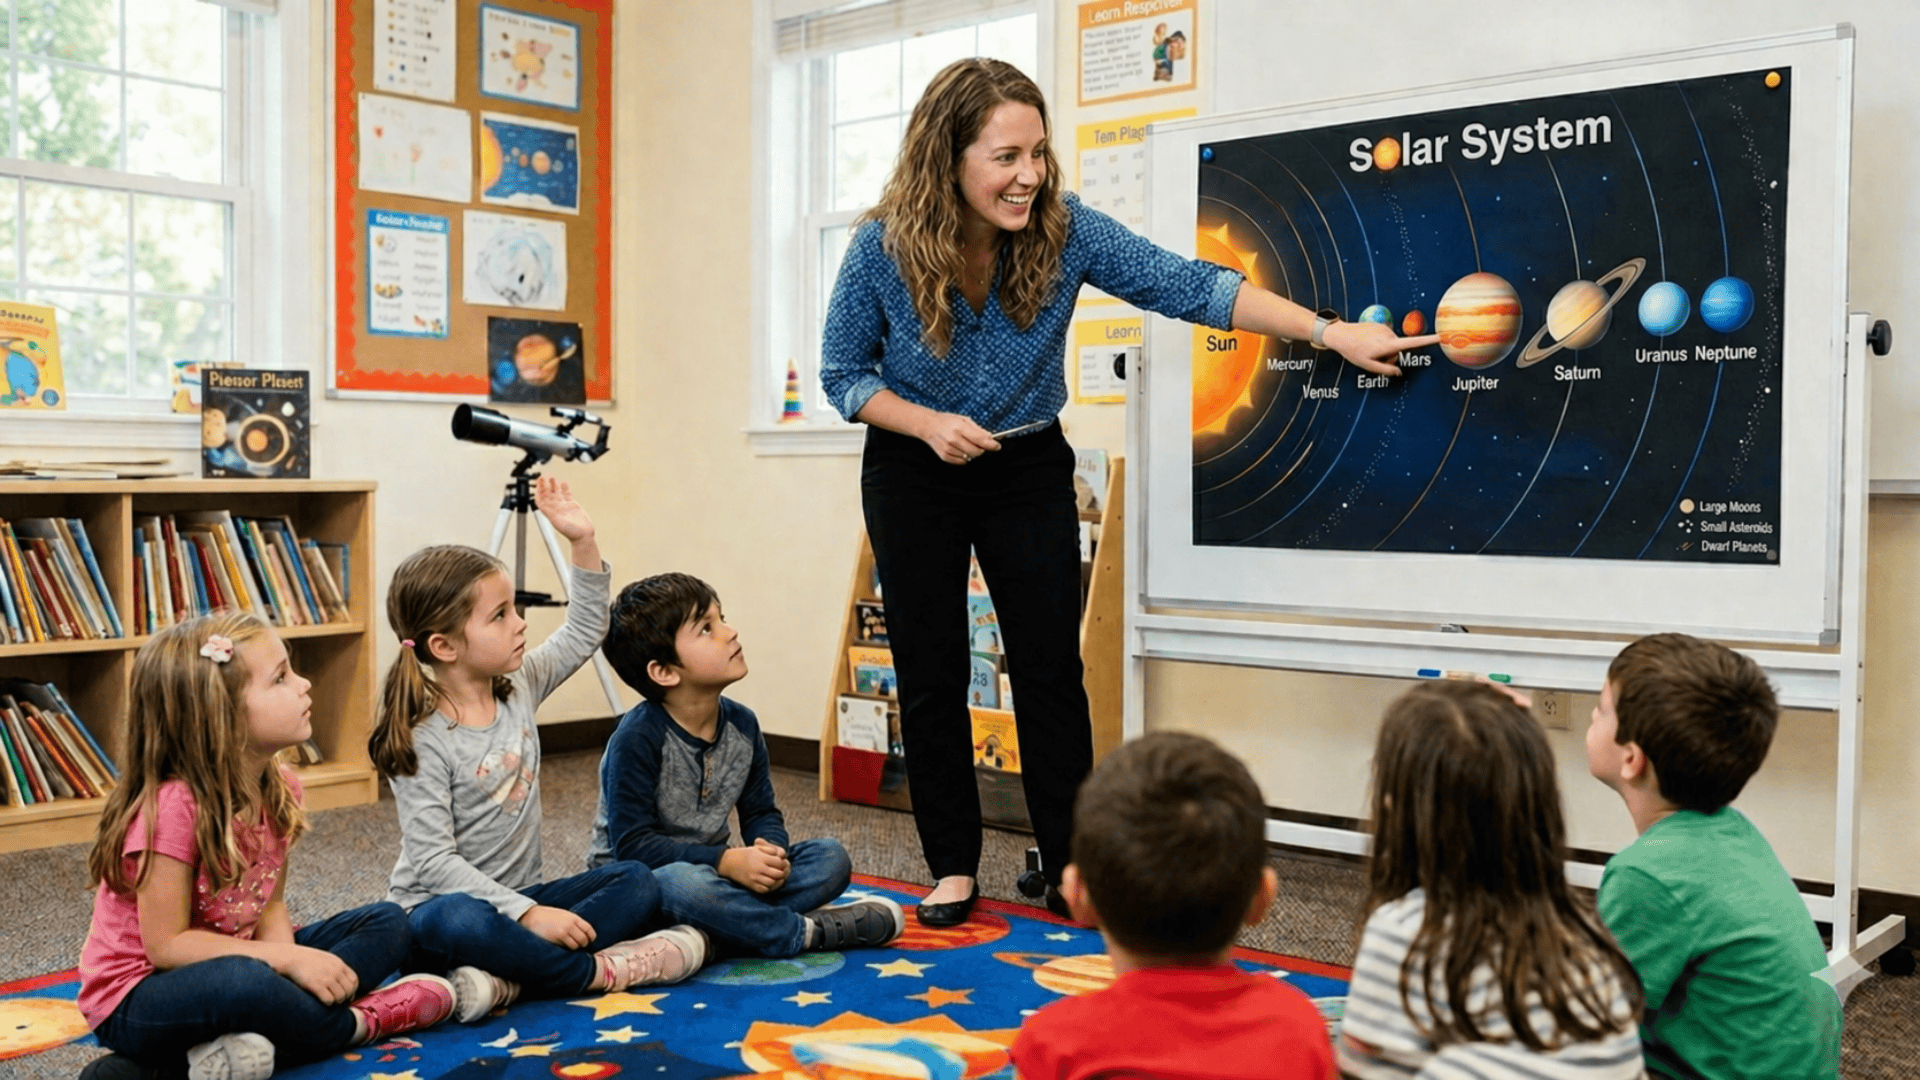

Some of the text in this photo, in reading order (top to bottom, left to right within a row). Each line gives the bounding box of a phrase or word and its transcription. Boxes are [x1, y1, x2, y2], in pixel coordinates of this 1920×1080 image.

[1461, 114, 1612, 166] System
[1105, 325, 1142, 340] Learn
[1206, 335, 1238, 352] Sun
[1399, 351, 1432, 367] Mars
[1635, 347, 1688, 363] Uranus
[1695, 345, 1757, 364] Neptune
[1266, 358, 1314, 373] Mercury
[1553, 364, 1602, 381] Saturn
[1357, 373, 1389, 389] Earth
[1451, 376, 1500, 393] Jupiter
[1302, 383, 1340, 400] Venus
[1700, 501, 1761, 515] Large Moons
[1701, 520, 1773, 534] Small Asteroids
[1701, 540, 1767, 553] Dwarf Planets
